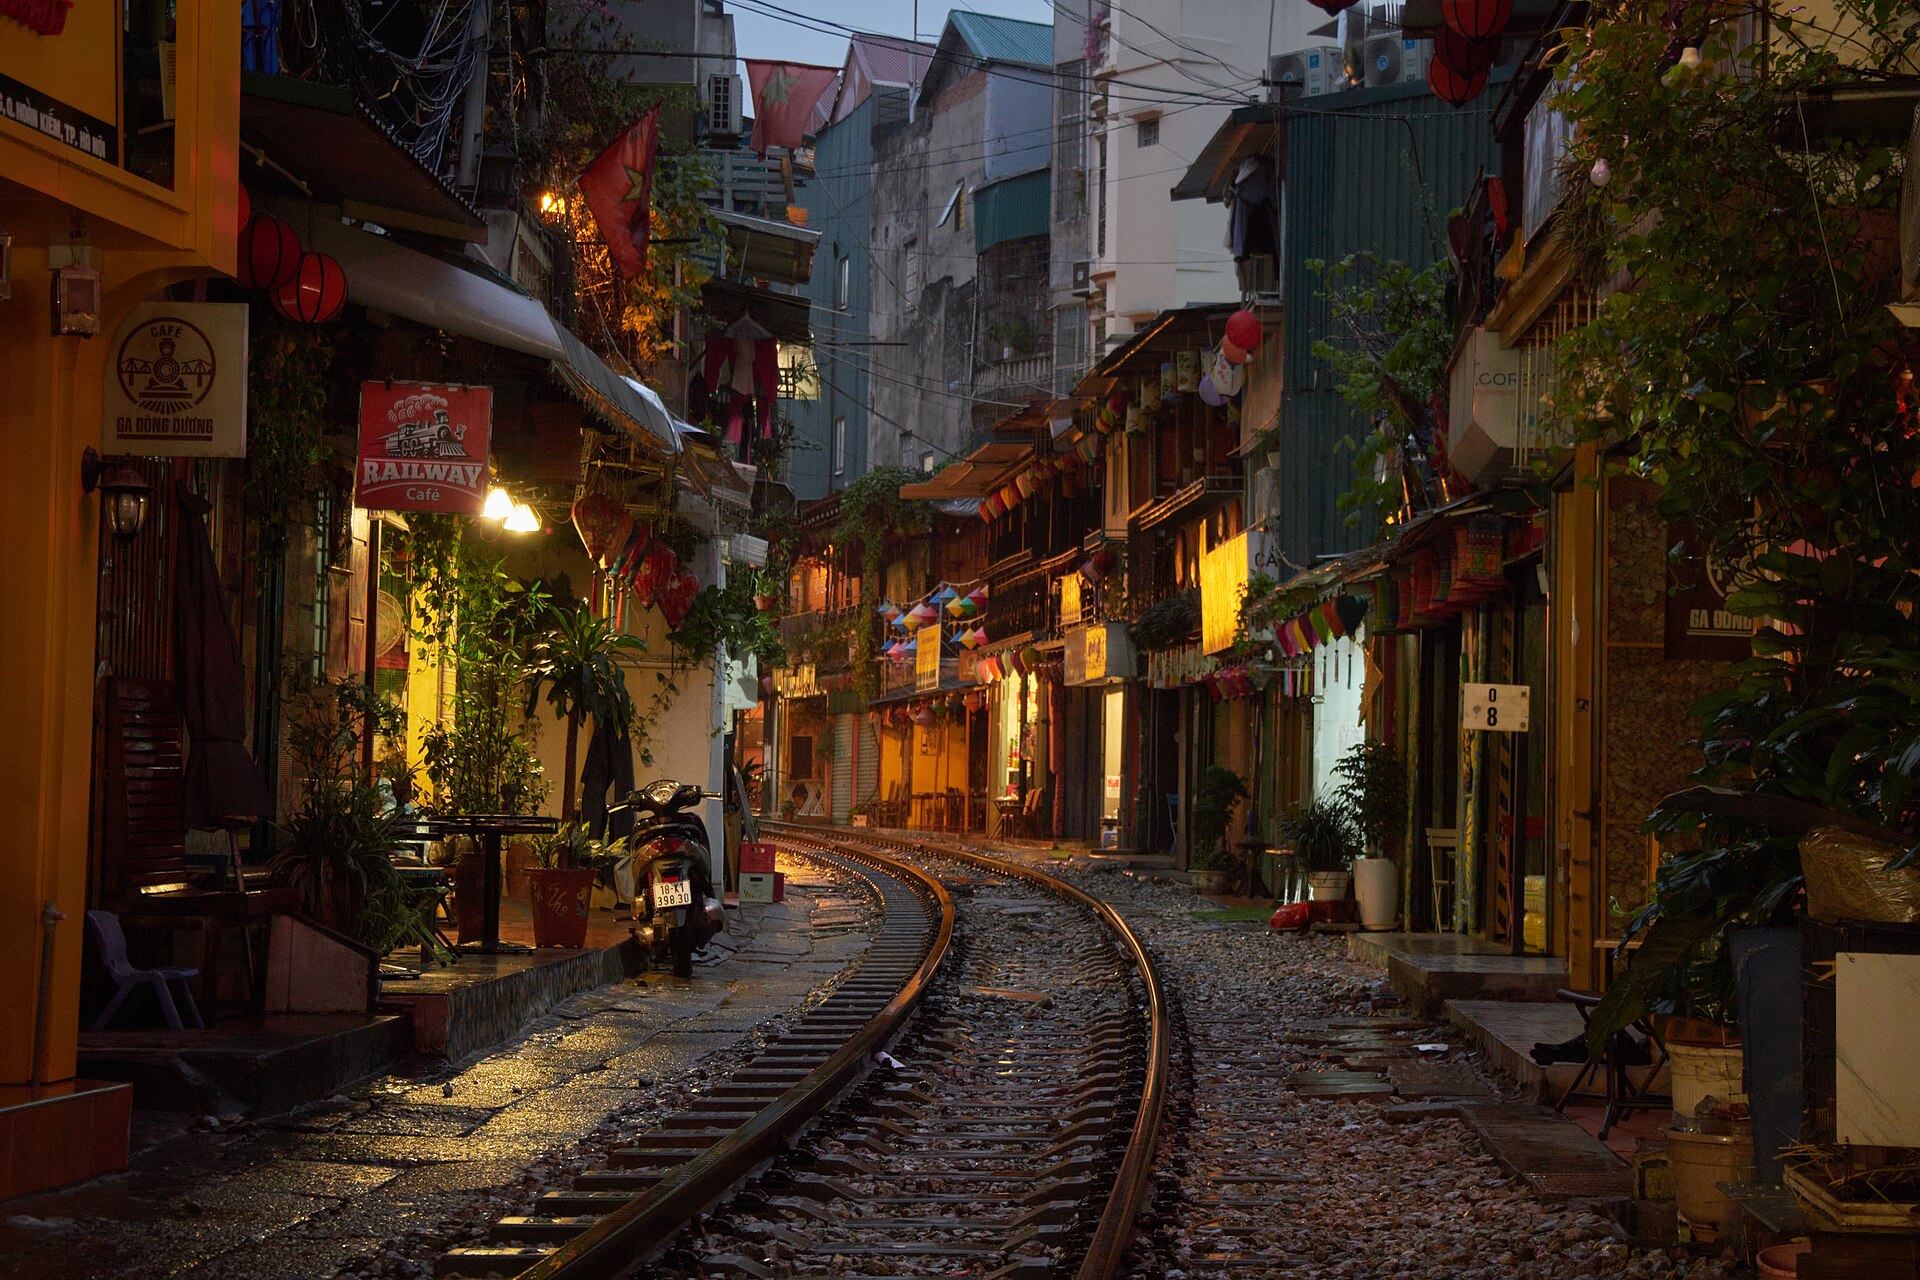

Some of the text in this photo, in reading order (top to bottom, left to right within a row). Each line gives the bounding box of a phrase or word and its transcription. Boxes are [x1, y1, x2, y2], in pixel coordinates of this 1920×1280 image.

[64, 122, 79, 148] TP.
[117, 414, 213, 434] GA ĐÔNG DƯƠNG
[362, 461, 482, 489] RAILWAY
[406, 487, 440, 501] Café
[1689, 608, 1709, 629] GA
[657, 892, 689, 906] 398.30
[660, 883, 685, 895] 18-K1
